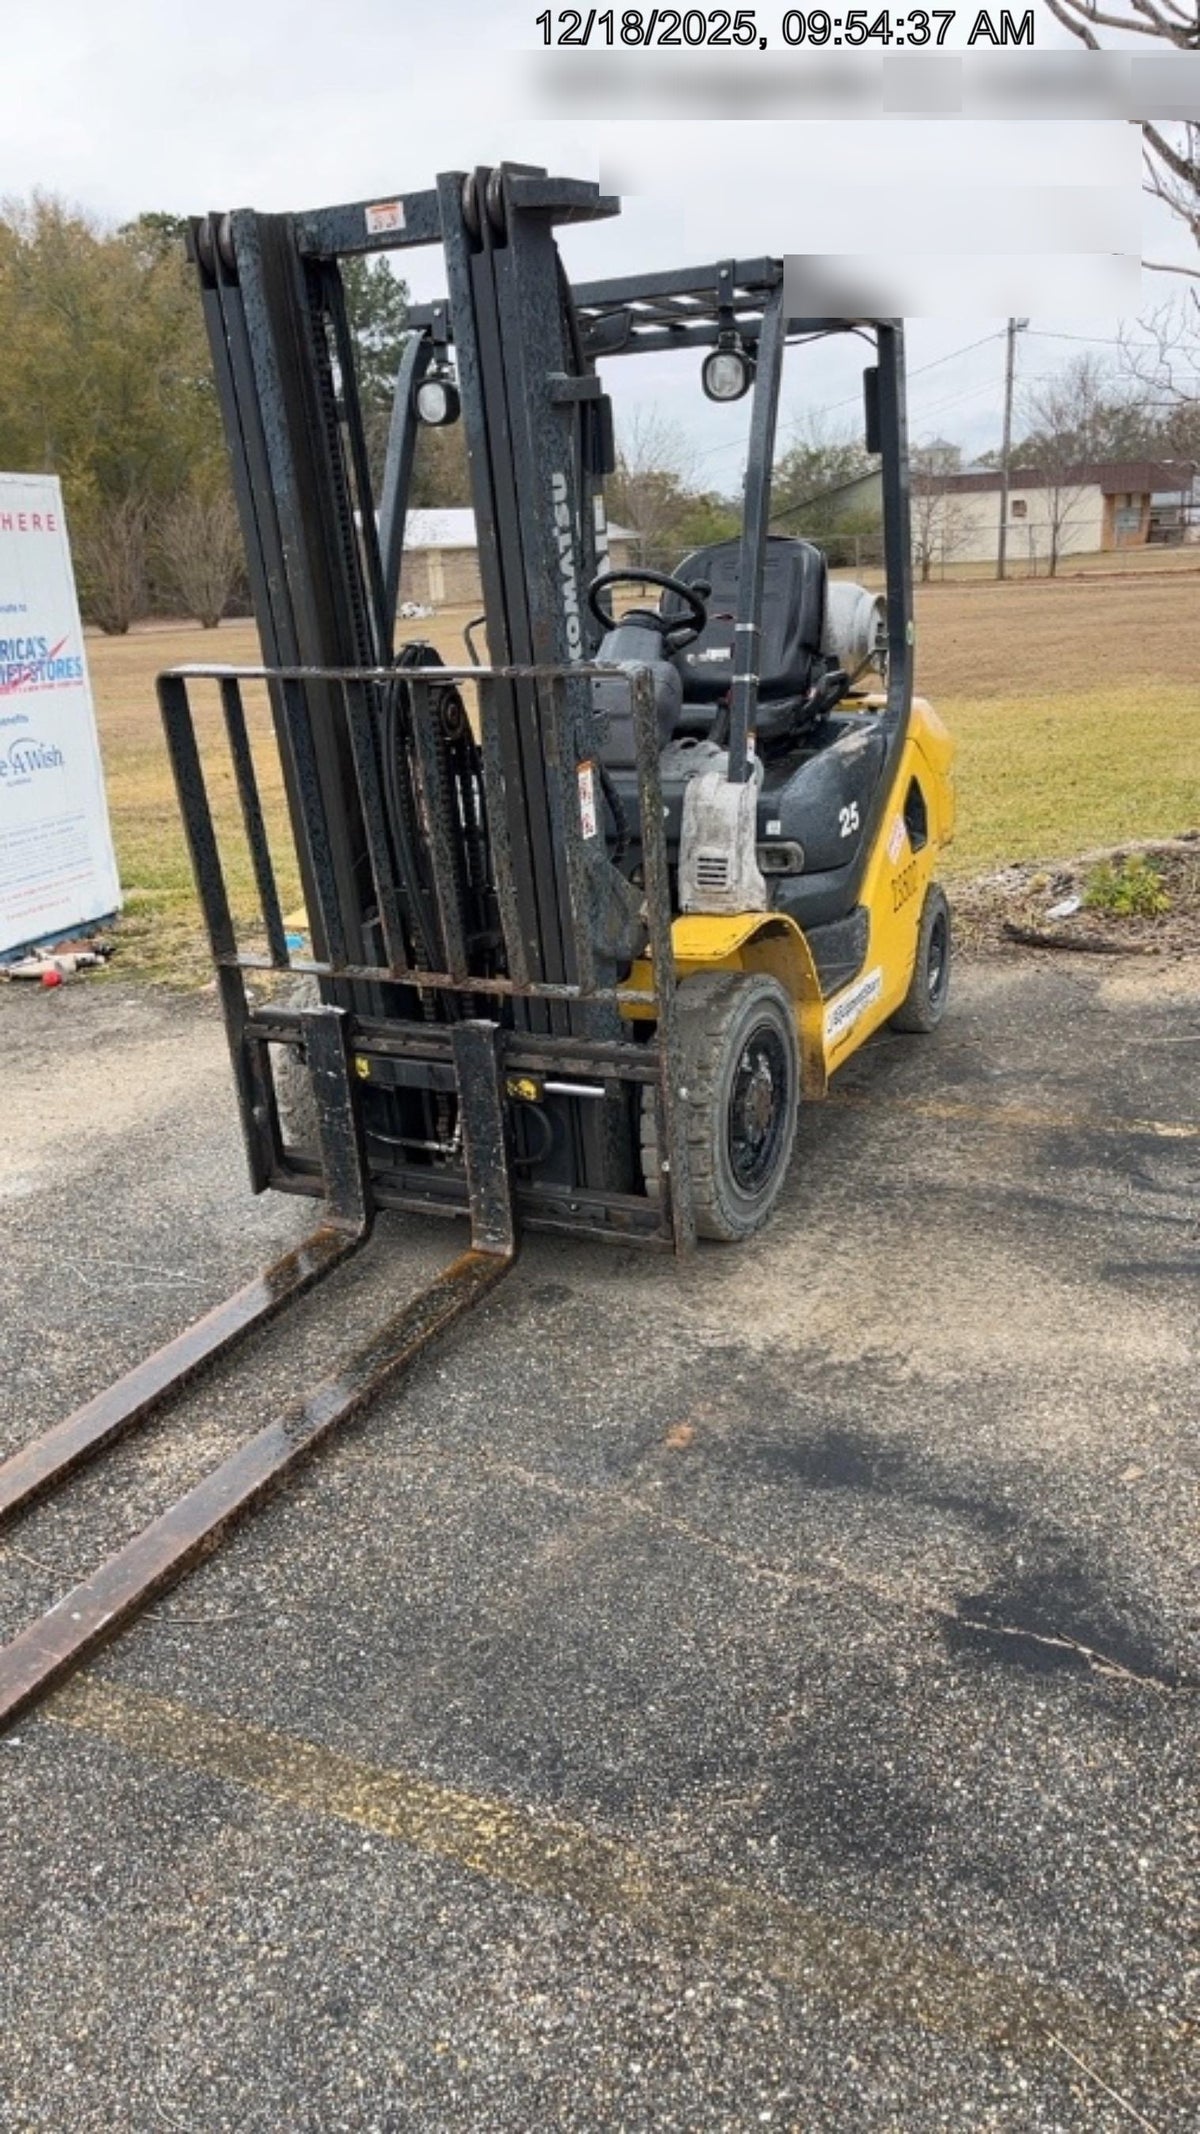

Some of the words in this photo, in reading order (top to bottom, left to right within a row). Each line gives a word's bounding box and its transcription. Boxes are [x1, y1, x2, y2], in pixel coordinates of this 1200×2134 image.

[1, 512, 57, 532] HERE
[24, 742, 65, 771] Wish
[839, 800, 860, 838] 25
